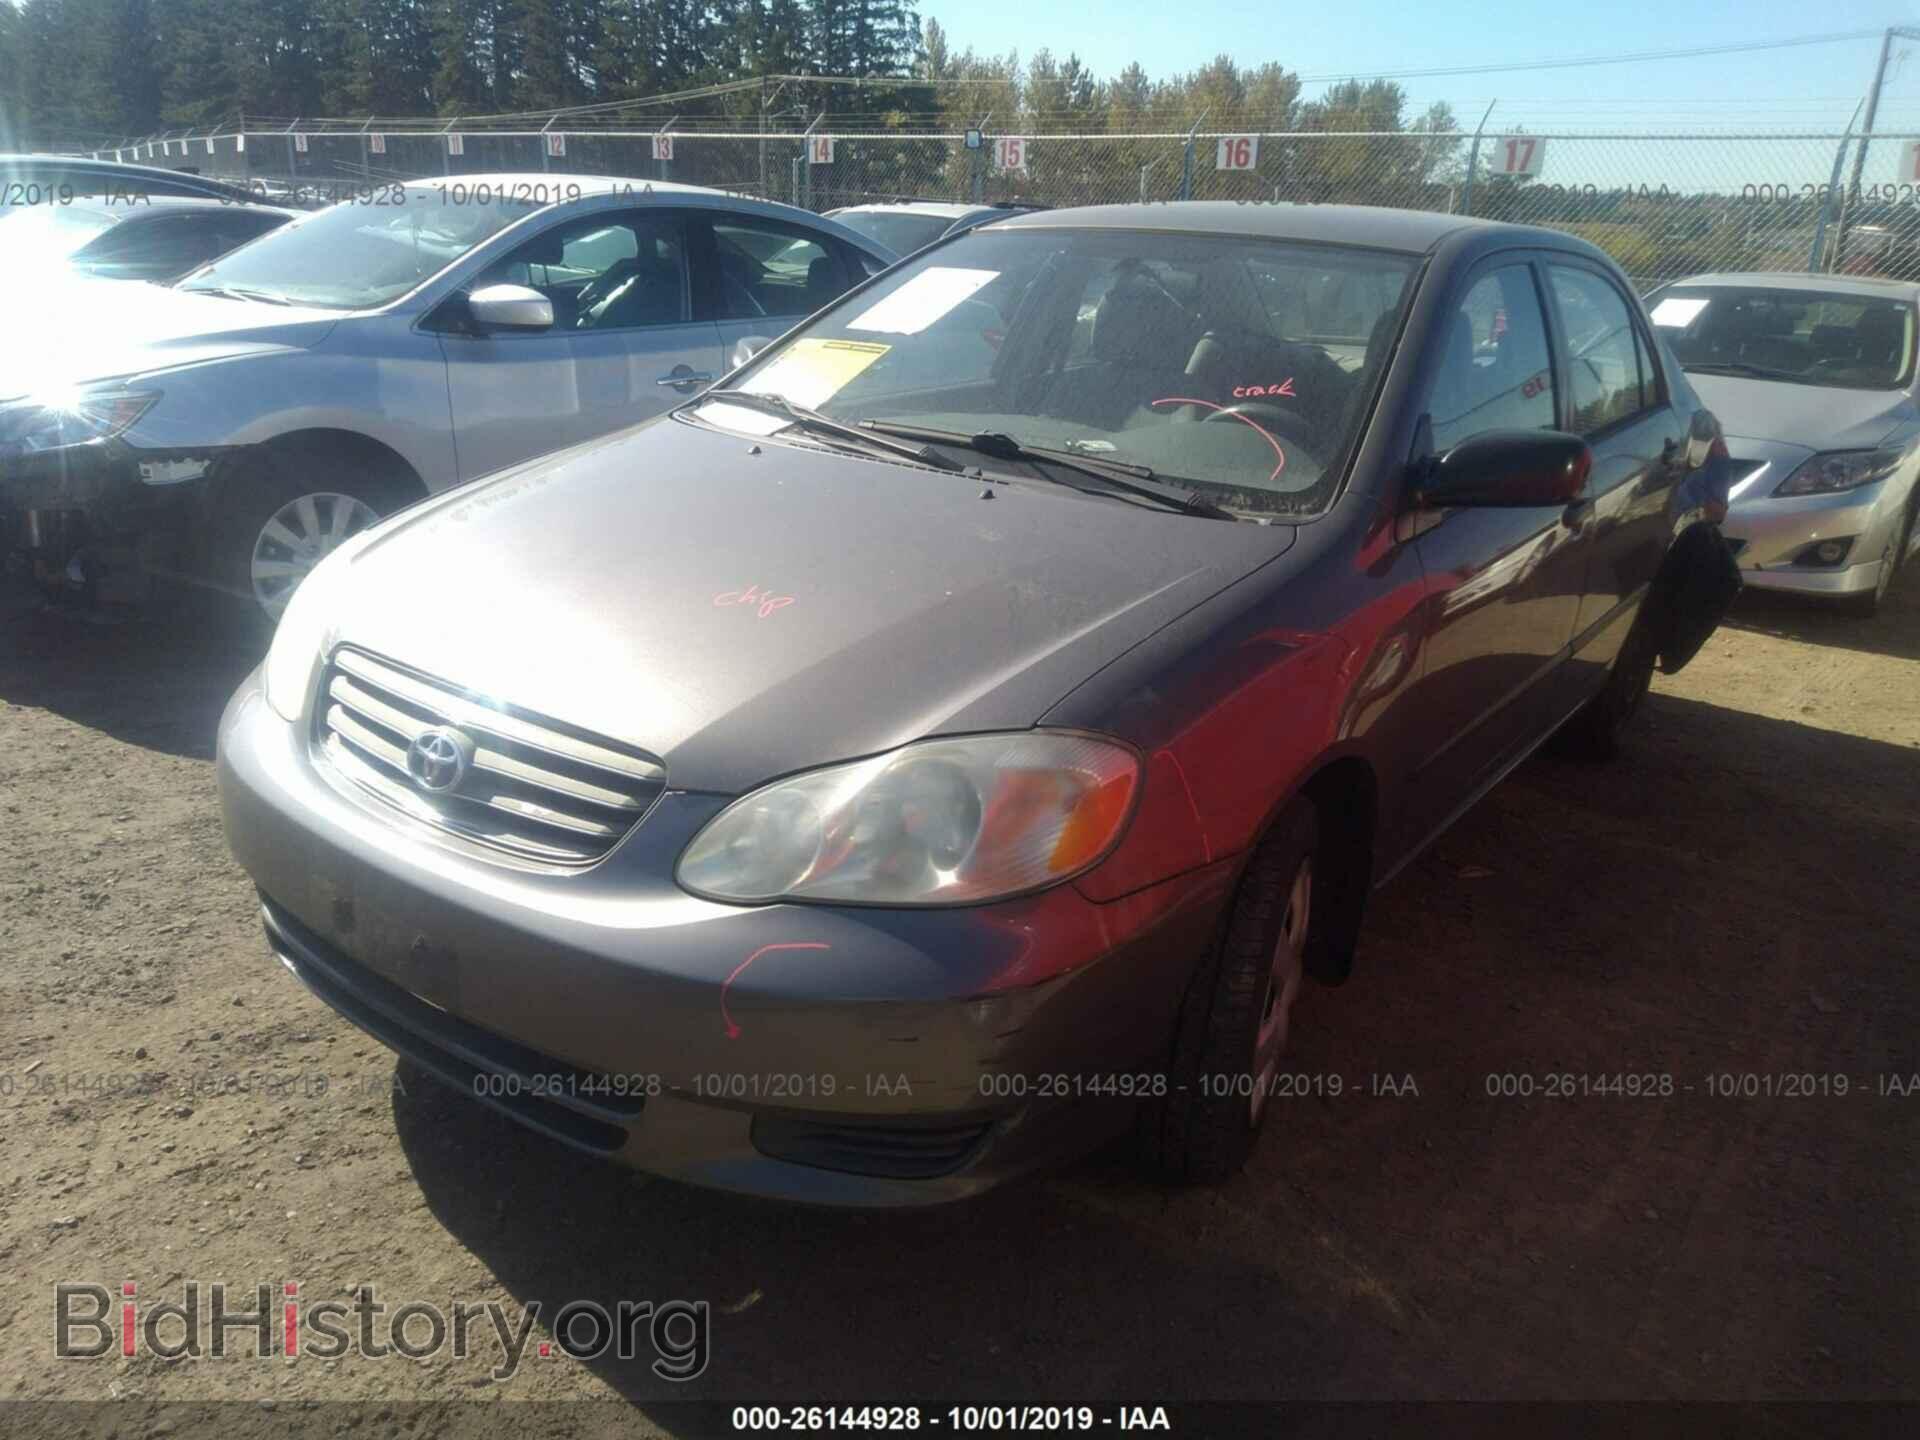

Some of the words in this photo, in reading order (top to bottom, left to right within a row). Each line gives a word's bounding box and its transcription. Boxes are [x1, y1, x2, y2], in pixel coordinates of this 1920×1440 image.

[450, 135, 462, 153] 11
[550, 135, 562, 155] 12
[656, 136, 671, 159] 13
[814, 137, 830, 160] 14
[1000, 140, 1020, 167] 15
[1224, 138, 1250, 168] 16
[1505, 139, 1537, 172] 17
[1232, 377, 1297, 398] crack
[713, 584, 797, 618] chip
